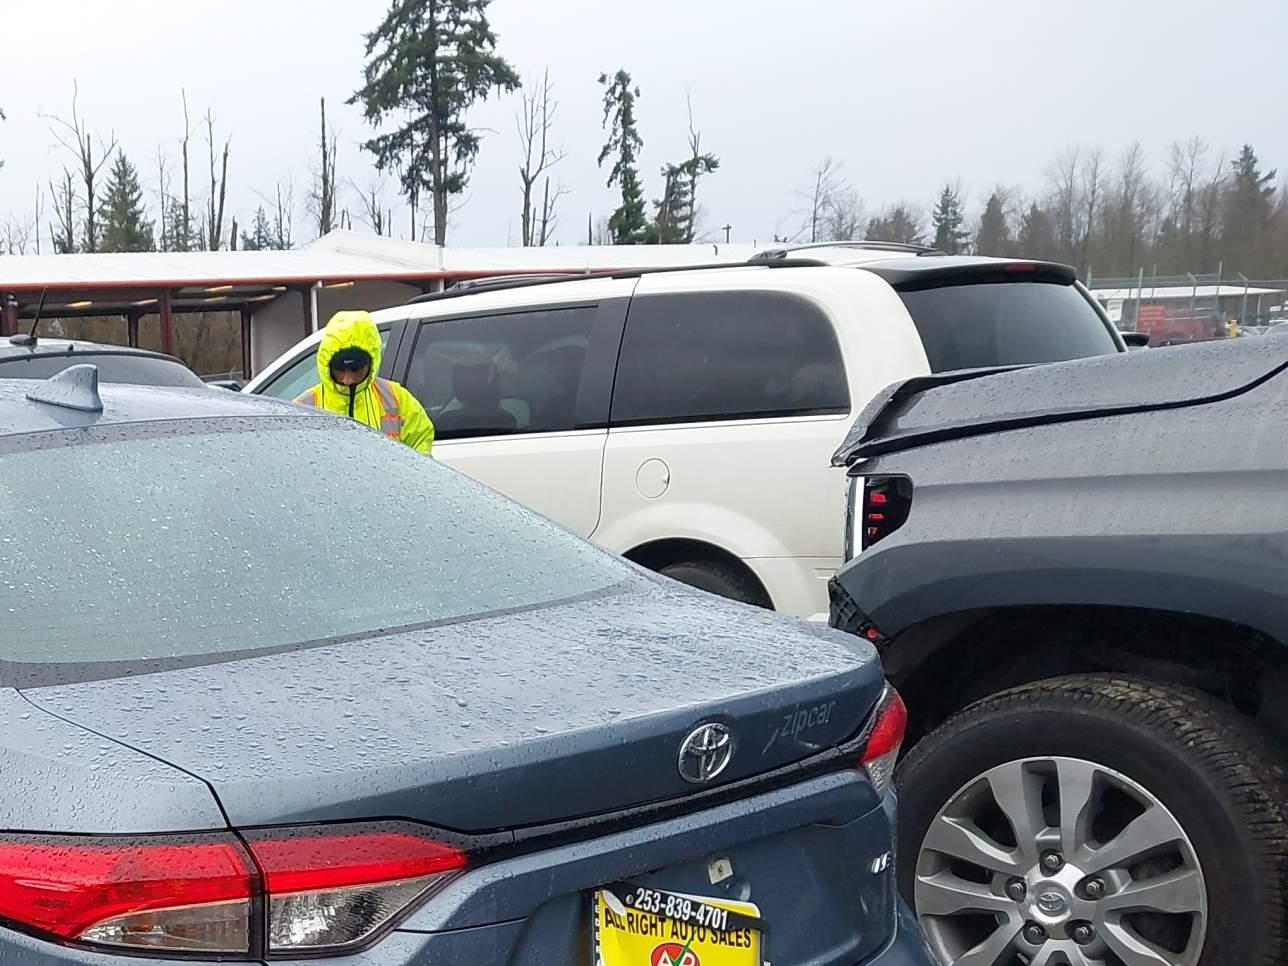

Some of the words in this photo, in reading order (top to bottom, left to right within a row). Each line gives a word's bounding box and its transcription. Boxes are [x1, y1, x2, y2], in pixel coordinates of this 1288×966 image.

[781, 700, 837, 740] zipcar
[604, 907, 626, 931] ALL
[626, 911, 667, 938] RIGHT
[670, 918, 707, 943] AUTO
[710, 928, 752, 949] SALES
[634, 887, 728, 931] 253-839-4701
